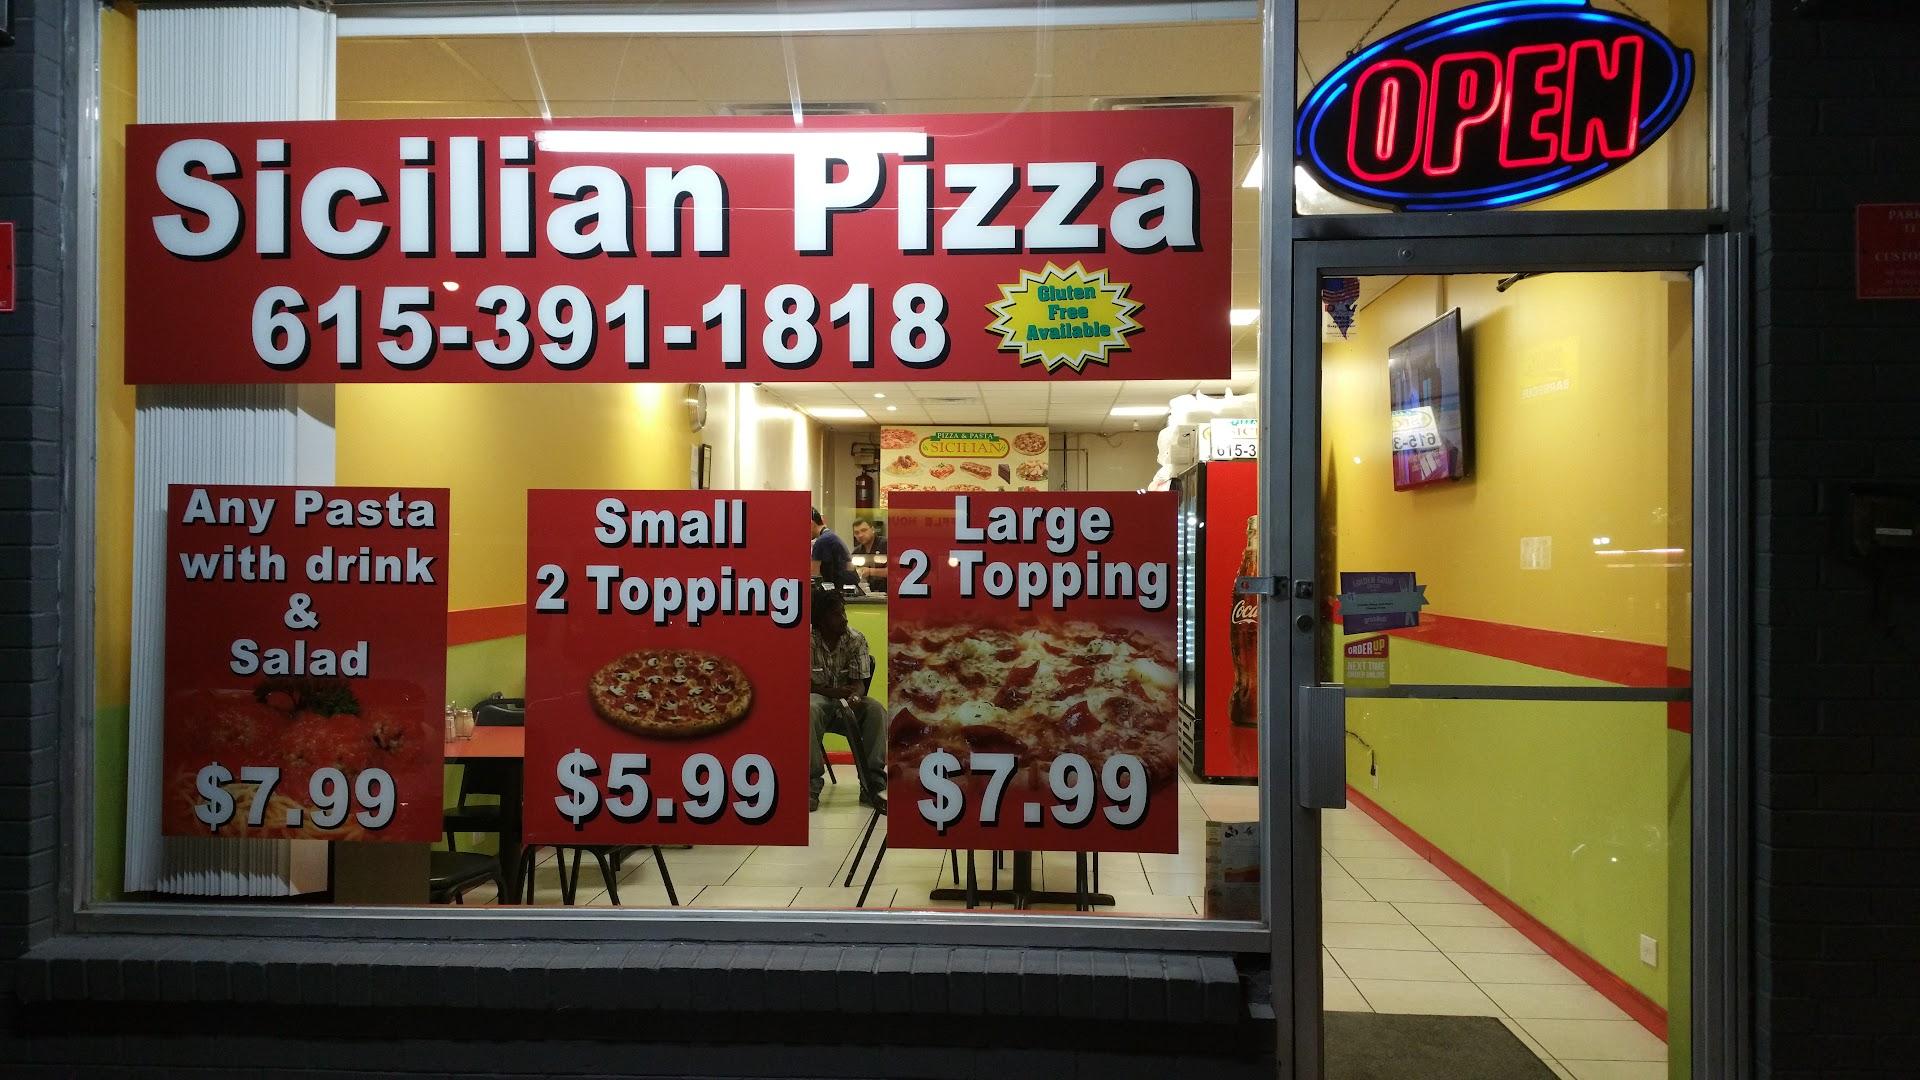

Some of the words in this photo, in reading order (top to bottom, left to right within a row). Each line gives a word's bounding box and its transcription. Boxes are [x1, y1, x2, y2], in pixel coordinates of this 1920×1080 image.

[1347, 35, 1644, 181] OPEN
[152, 136, 728, 262] Sicilian
[794, 133, 1202, 255] Pizza
[1037, 285, 1096, 302] Gluten
[1048, 304, 1089, 321] Free
[252, 284, 950, 370] 615-391-1818
[1026, 322, 1111, 341] Available
[930, 441, 1002, 454] SICILIAN
[970, 432, 993, 440] PASTA
[182, 488, 276, 534] Any
[294, 490, 436, 529] Pasta
[594, 498, 746, 548] Small
[954, 495, 1113, 555] Large
[180, 545, 287, 582] with
[305, 546, 437, 584] drink
[898, 549, 931, 598] 2
[949, 550, 1170, 611] Topping
[283, 592, 319, 630] &
[535, 564, 569, 612] 2
[586, 565, 802, 628] Topping
[229, 638, 370, 678] Salad
[1347, 641, 1373, 655] ORDER
[1373, 638, 1385, 652] UP
[194, 761, 397, 831] $7.99
[554, 748, 779, 831] $5.99
[917, 748, 1150, 834] $7.99
